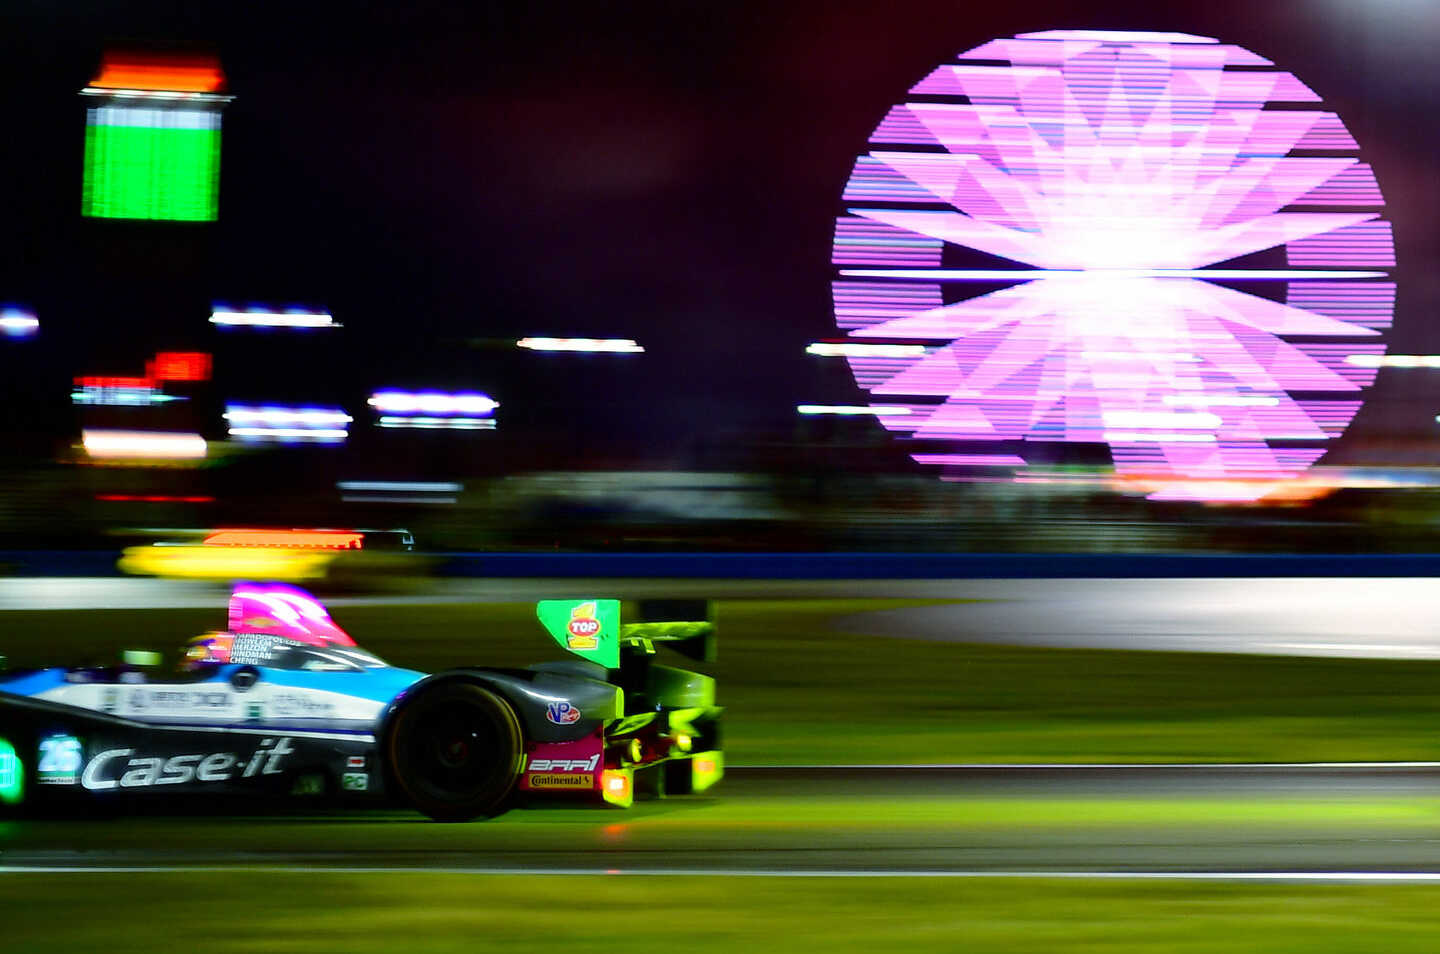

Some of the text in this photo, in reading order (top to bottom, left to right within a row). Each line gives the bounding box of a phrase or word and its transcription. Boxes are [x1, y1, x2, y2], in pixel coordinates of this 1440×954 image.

[571, 621, 598, 633] TOP
[229, 657, 259, 665] CHENG
[230, 651, 272, 660] HINDMAN
[548, 702, 570, 723] VP
[38, 740, 82, 772] 26
[531, 775, 582, 786] Continental
